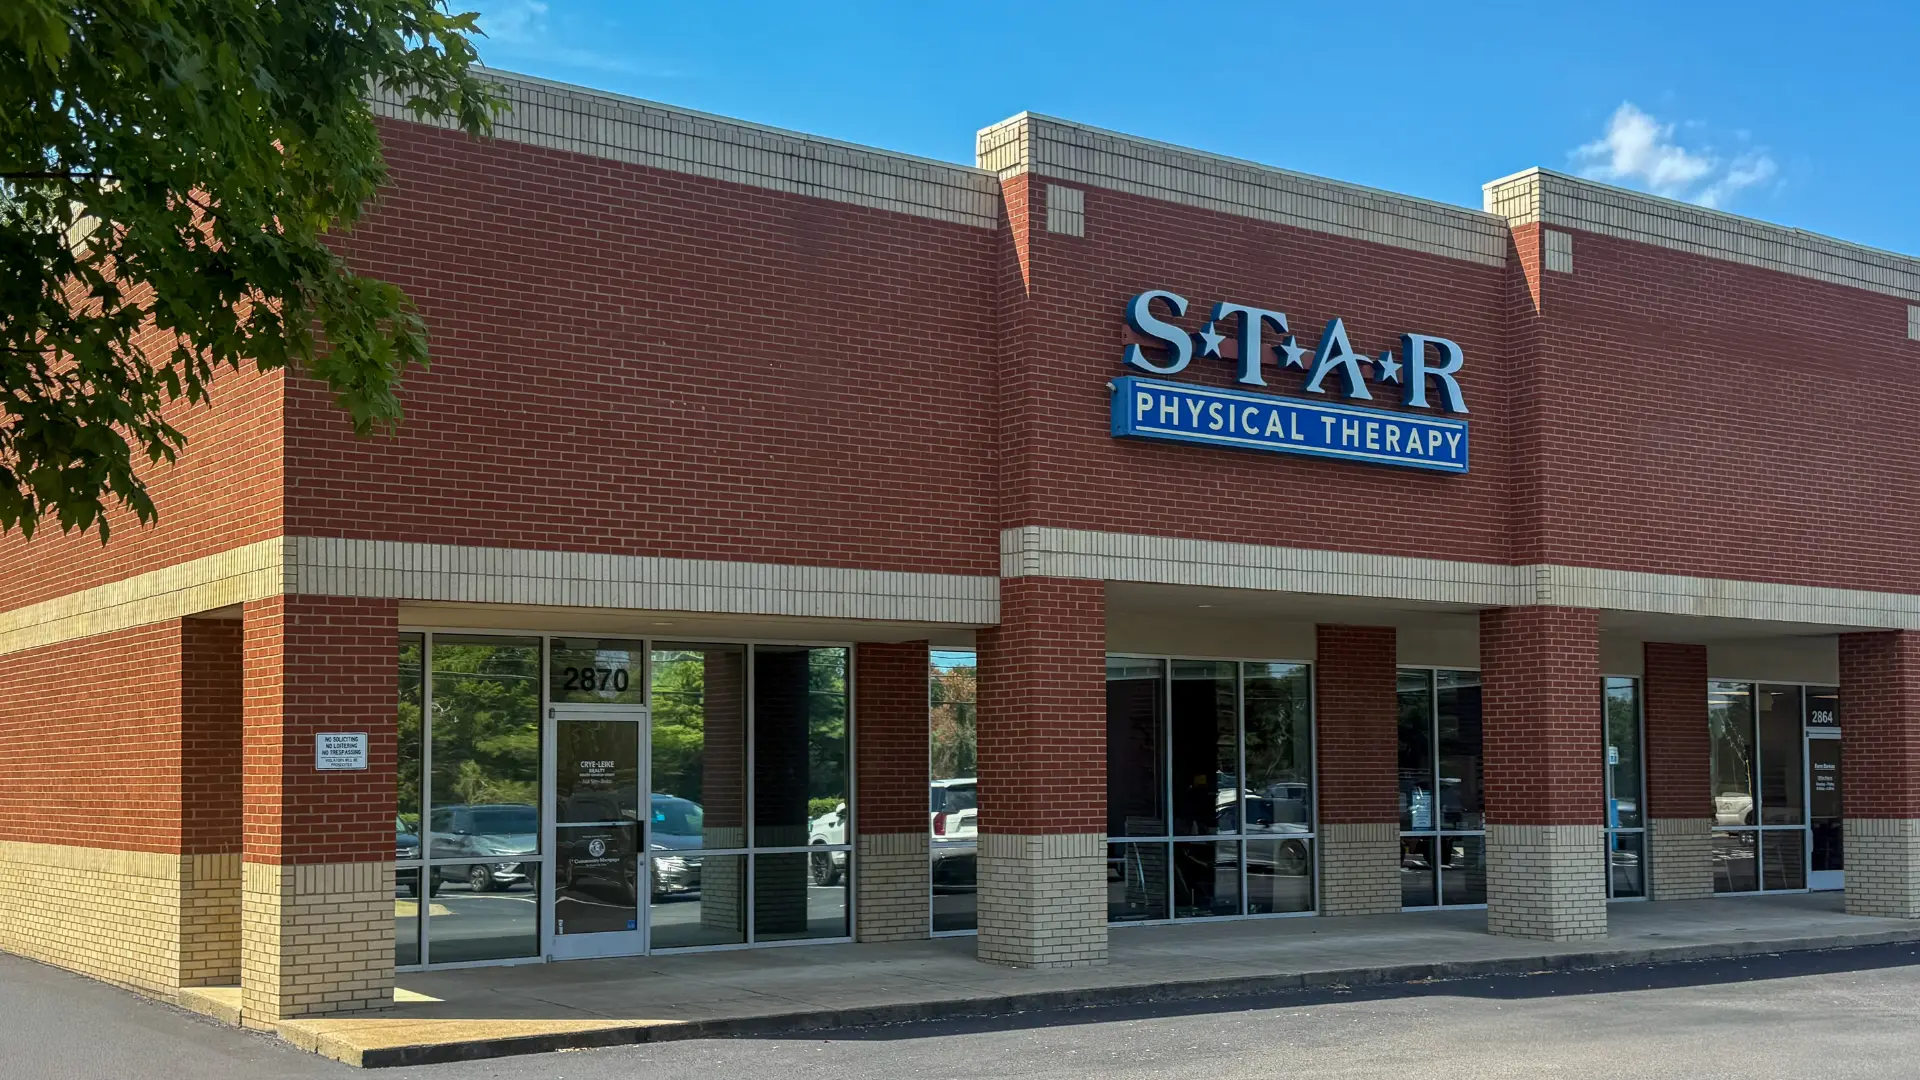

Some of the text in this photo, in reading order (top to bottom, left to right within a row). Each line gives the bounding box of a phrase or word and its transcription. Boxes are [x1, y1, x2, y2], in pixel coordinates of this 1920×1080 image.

[1136, 391, 1462, 460] PHYSICAL THERAPY
[563, 666, 629, 692] 2870
[1811, 710, 1833, 723] 2864
